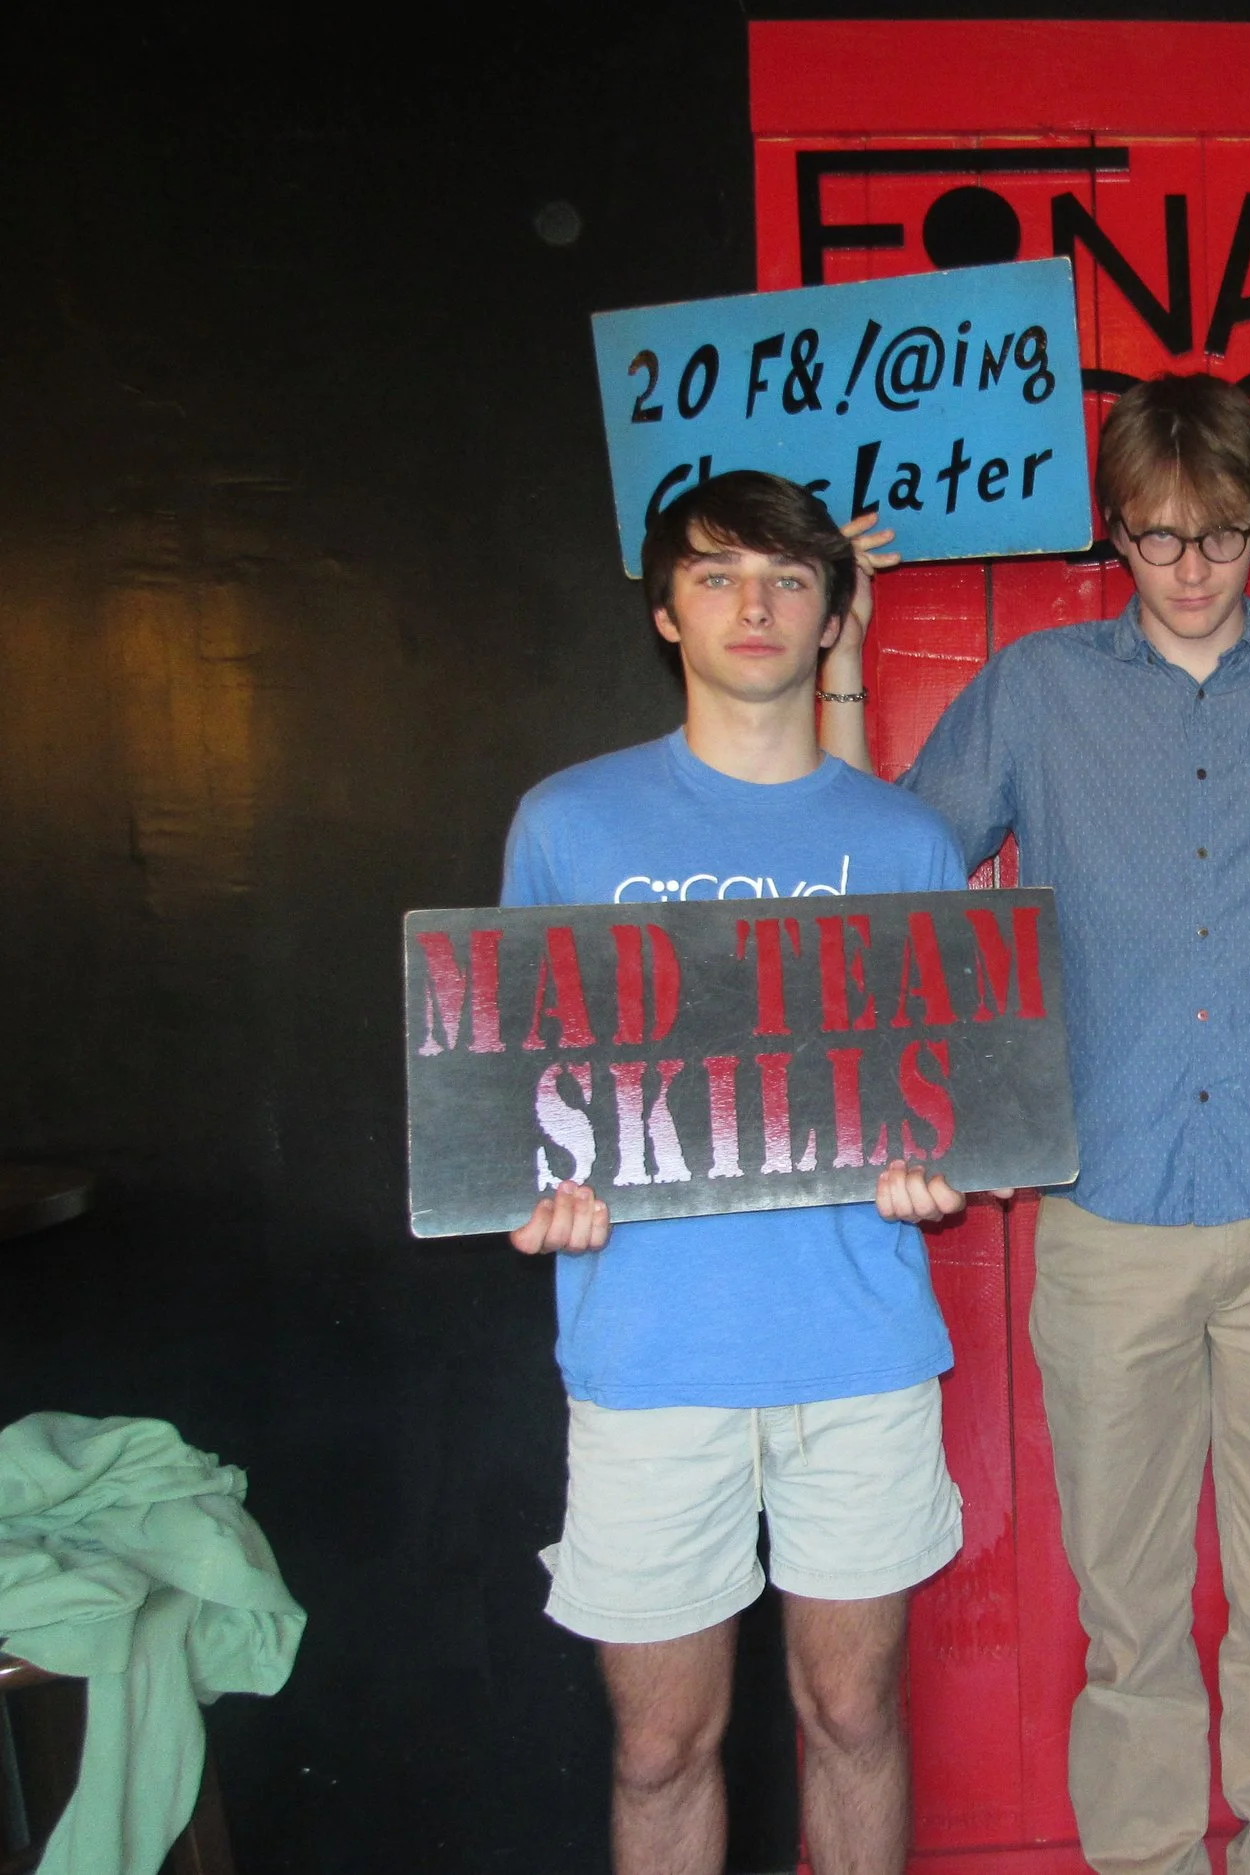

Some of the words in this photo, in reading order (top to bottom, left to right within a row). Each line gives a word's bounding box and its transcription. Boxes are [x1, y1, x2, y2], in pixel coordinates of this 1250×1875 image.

[627, 343, 719, 423] 20
[416, 922, 681, 1056] MAD
[736, 906, 1048, 1036] TEAM
[535, 1039, 956, 1192] SKILLS
